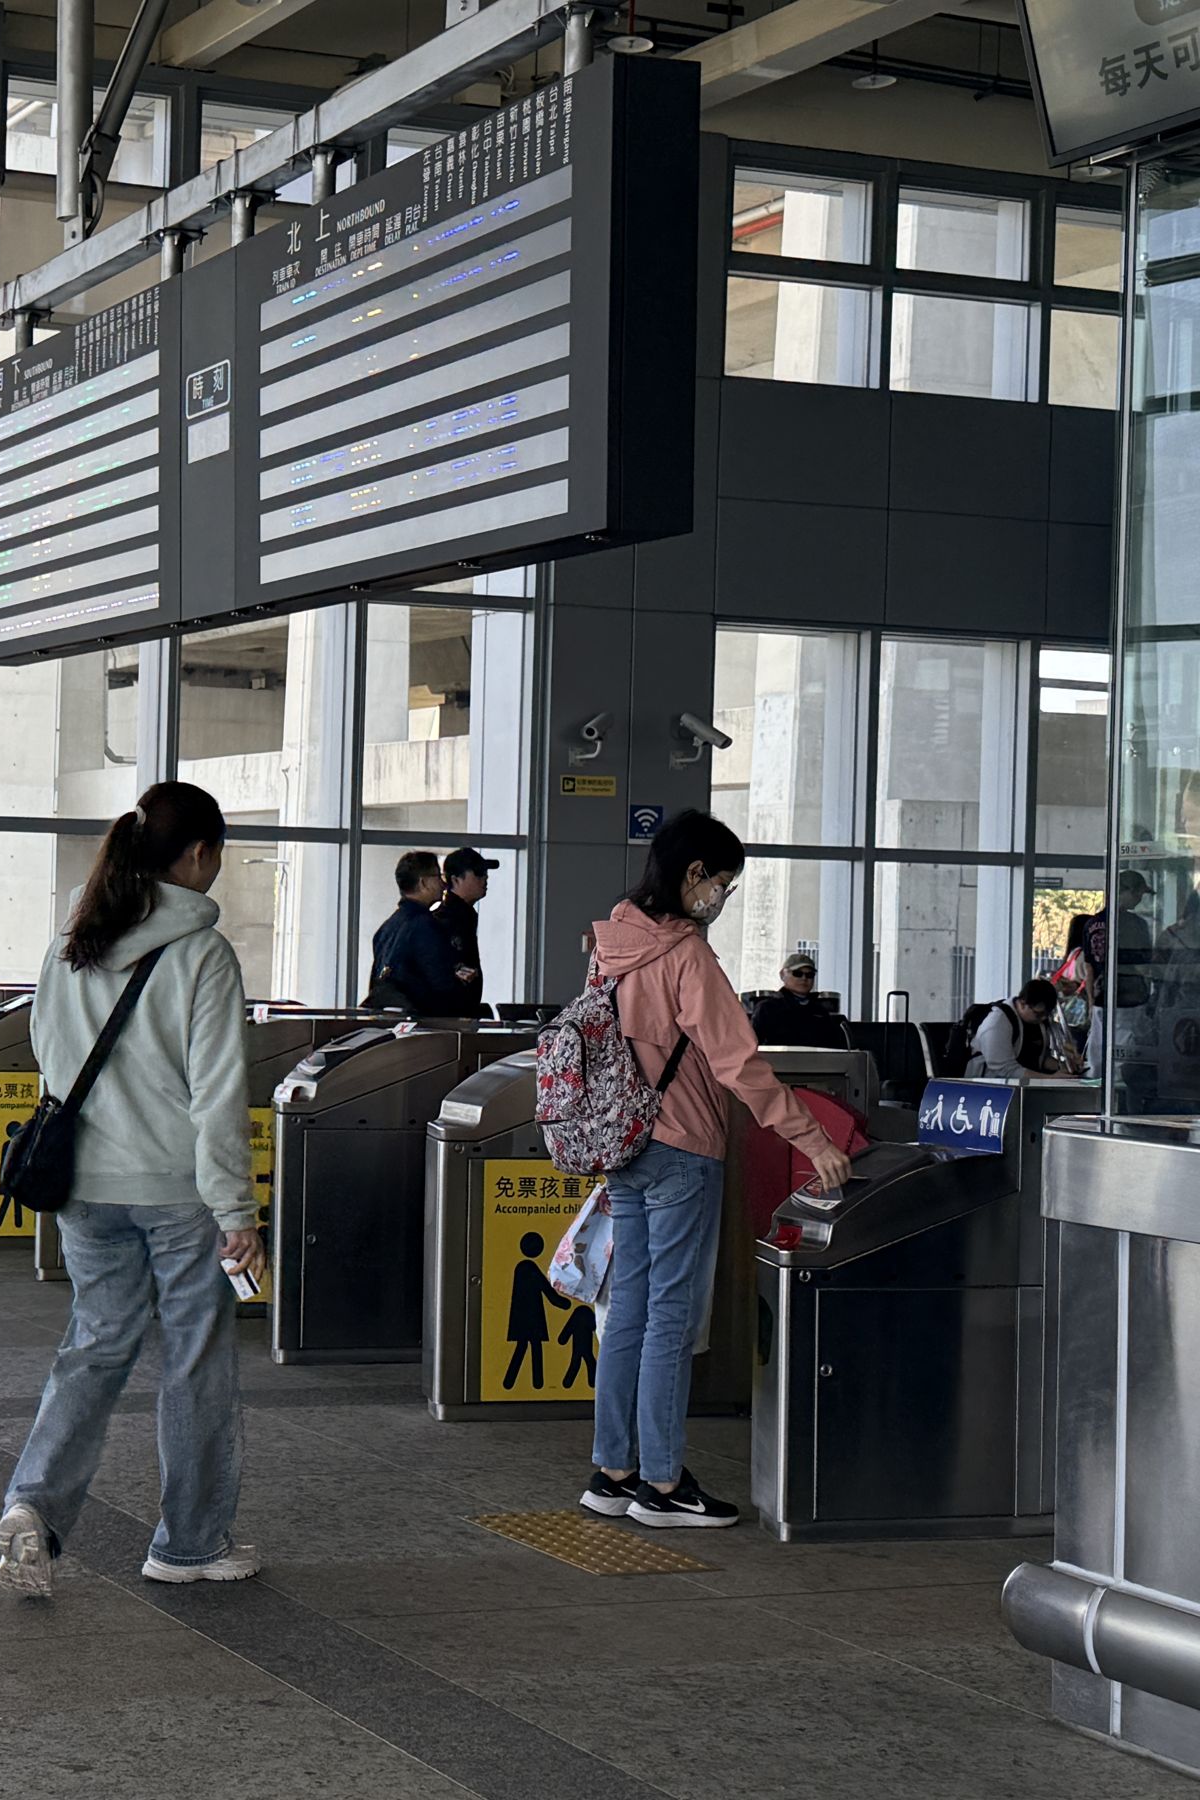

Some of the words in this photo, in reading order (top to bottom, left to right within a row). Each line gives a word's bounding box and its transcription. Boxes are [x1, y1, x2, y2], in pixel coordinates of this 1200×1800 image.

[1099, 26, 1200, 97] 每天可
[549, 86, 558, 121] 台北
[483, 119, 492, 153] 台中
[535, 129, 543, 175] Banqiao
[548, 122, 557, 157] Taipei
[563, 114, 571, 164] Nangang
[522, 136, 530, 178] Taoyuan
[286, 208, 331, 255] 北上
[336, 198, 386, 233] NORTHBOUND
[404, 203, 421, 225] 月台
[348, 222, 380, 250] 開車時間
[363, 240, 377, 256] TIME
[384, 230, 401, 246] DELAY
[314, 255, 347, 278] DESTINATION
[276, 280, 290, 295] TRAIN
[192, 365, 224, 400] 時刻
[1121, 845, 1130, 854] 50
[495, 1203, 561, 1216] Accompanied
[563, 1203, 580, 1214] chi
